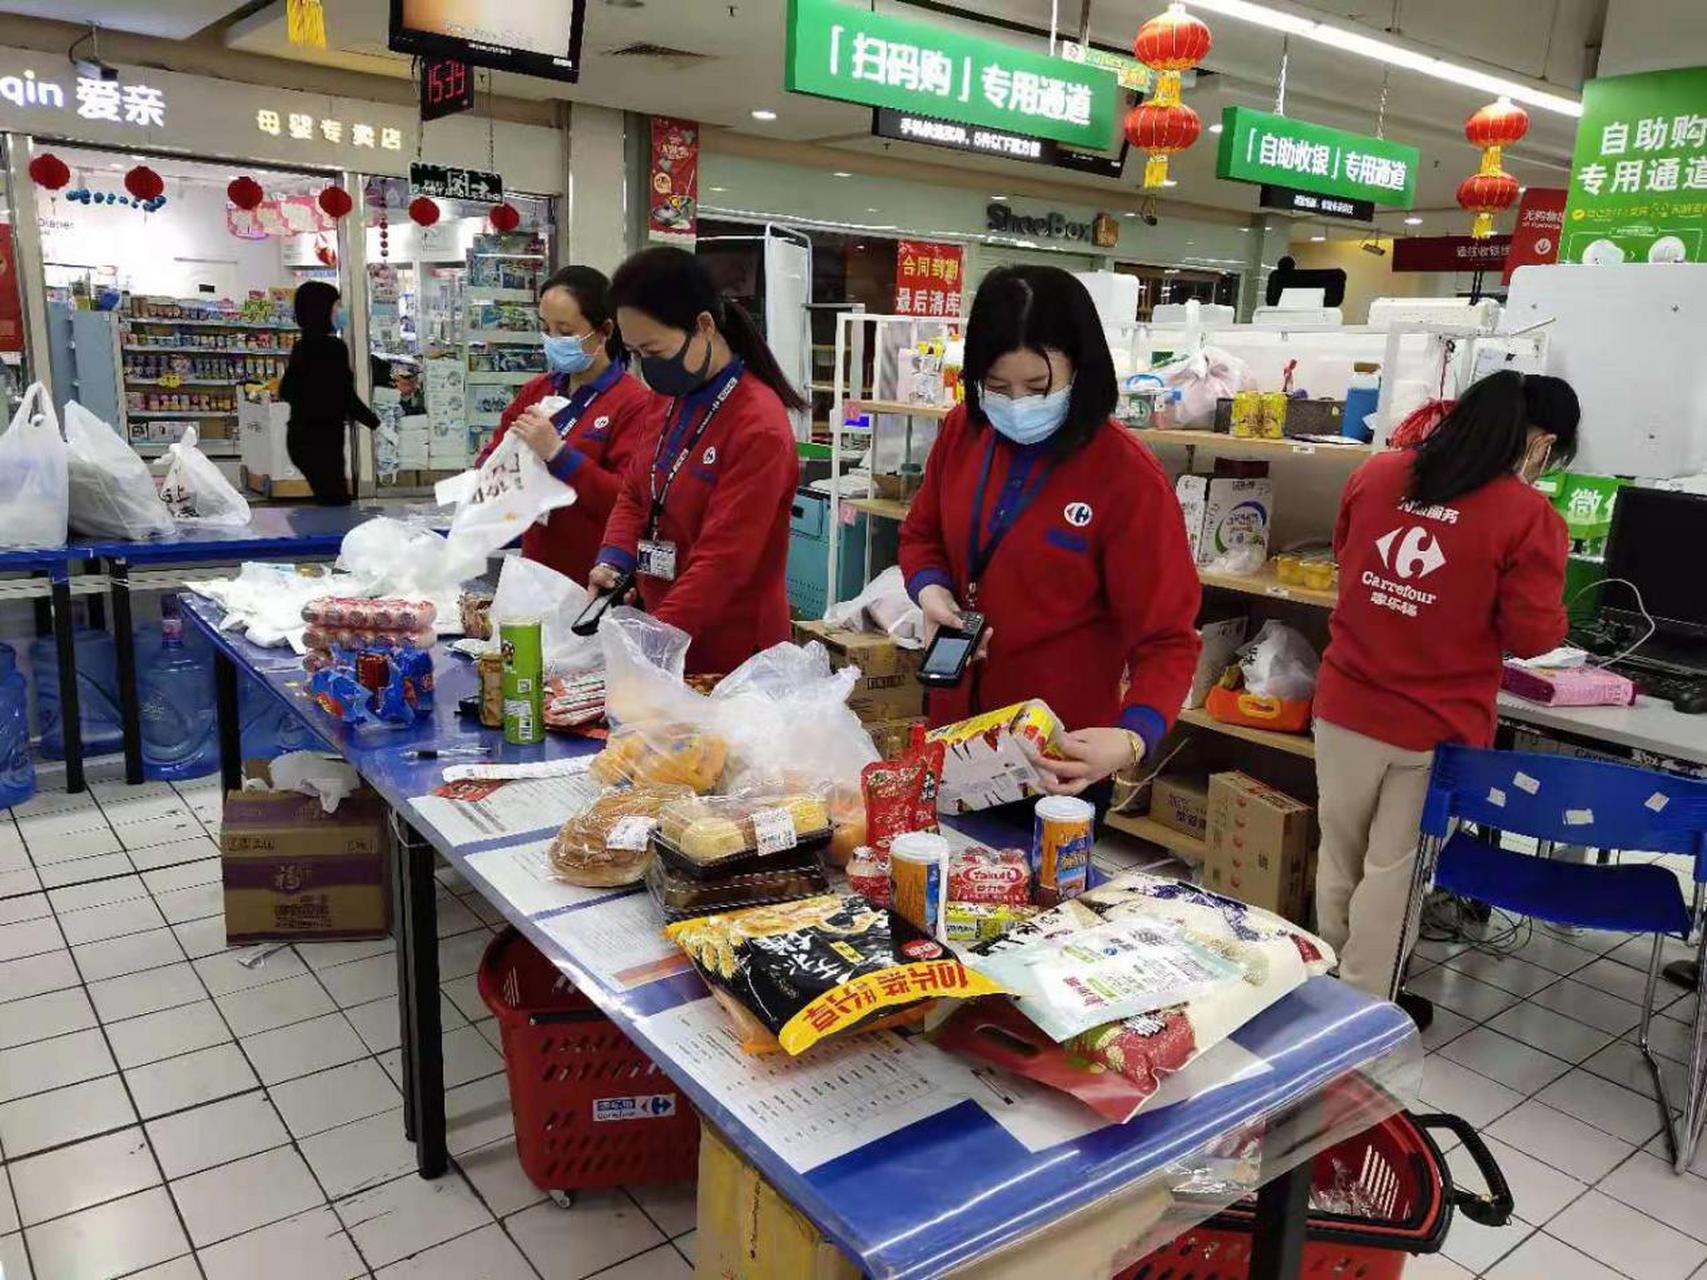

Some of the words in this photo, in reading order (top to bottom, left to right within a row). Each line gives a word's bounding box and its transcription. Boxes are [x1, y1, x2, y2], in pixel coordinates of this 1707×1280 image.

[76, 77, 166, 127] 爱亲
[256, 109, 401, 150] 母婴专卖店
[1246, 127, 1407, 191] 「自助收银」专用通道
[1577, 155, 1707, 196] 专用通道
[1361, 570, 1437, 605] Carrefour
[973, 868, 1017, 882] Yakult
